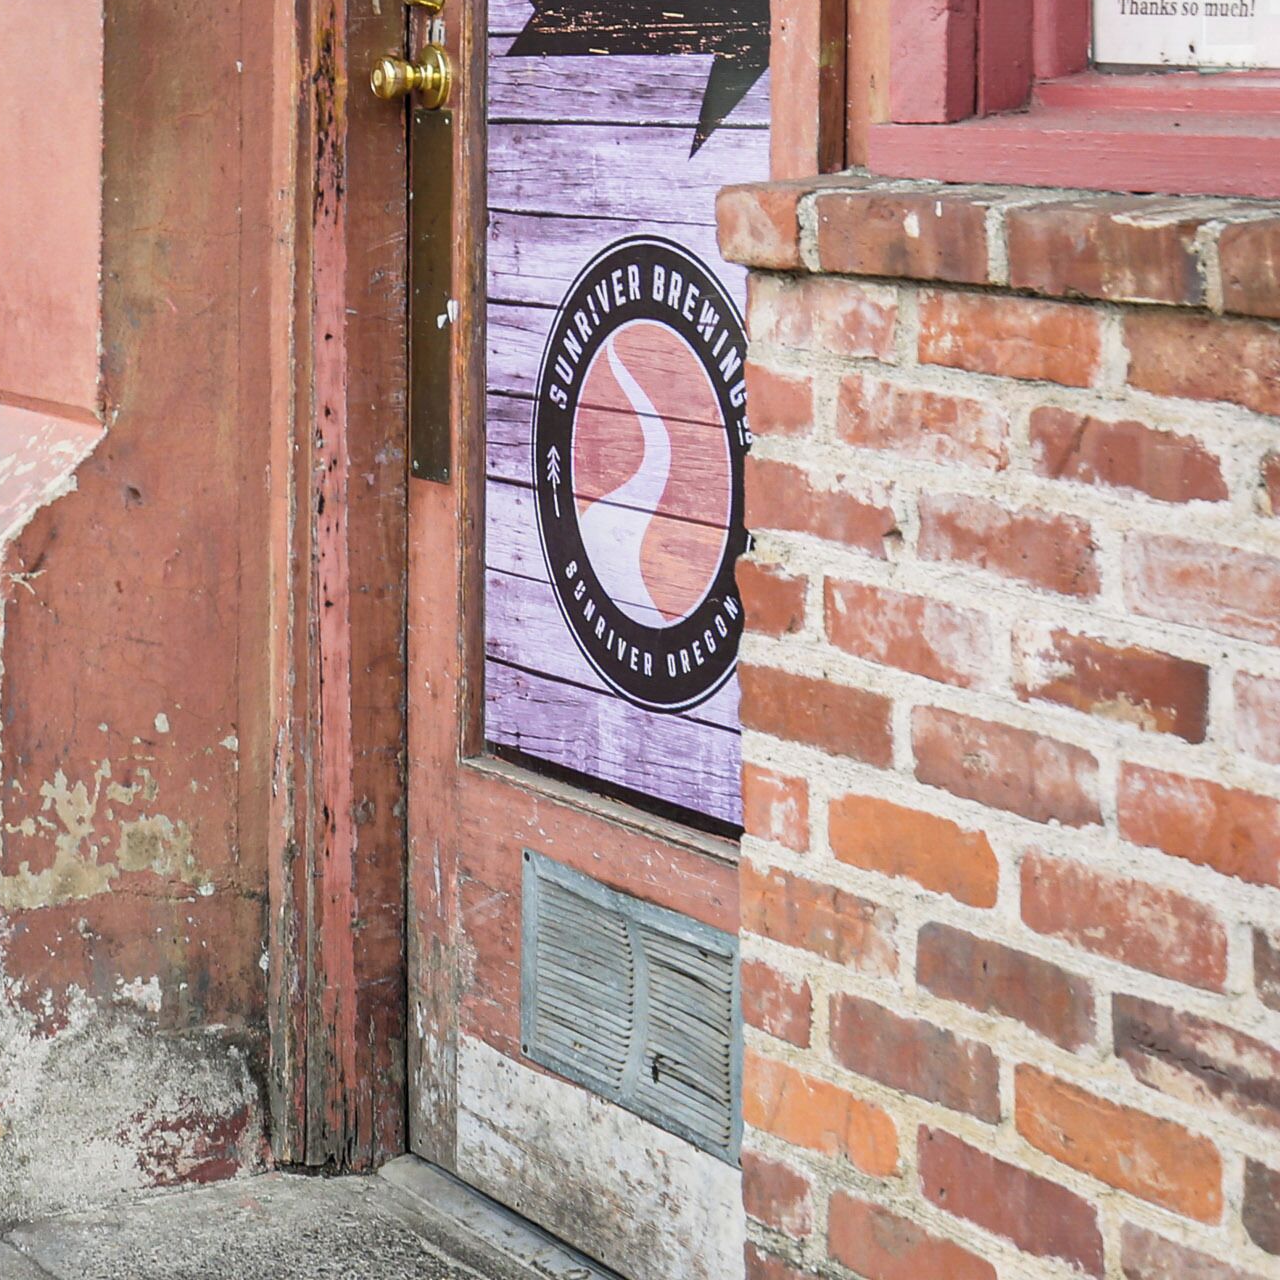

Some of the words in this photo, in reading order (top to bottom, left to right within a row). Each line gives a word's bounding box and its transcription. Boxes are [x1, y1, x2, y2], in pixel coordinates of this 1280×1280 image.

[1181, 3, 1199, 17] so
[549, 263, 641, 410] SUNRIVER
[652, 264, 748, 409] BREWING
[565, 560, 654, 677] SUNRIVER
[666, 594, 740, 678] OREGON
